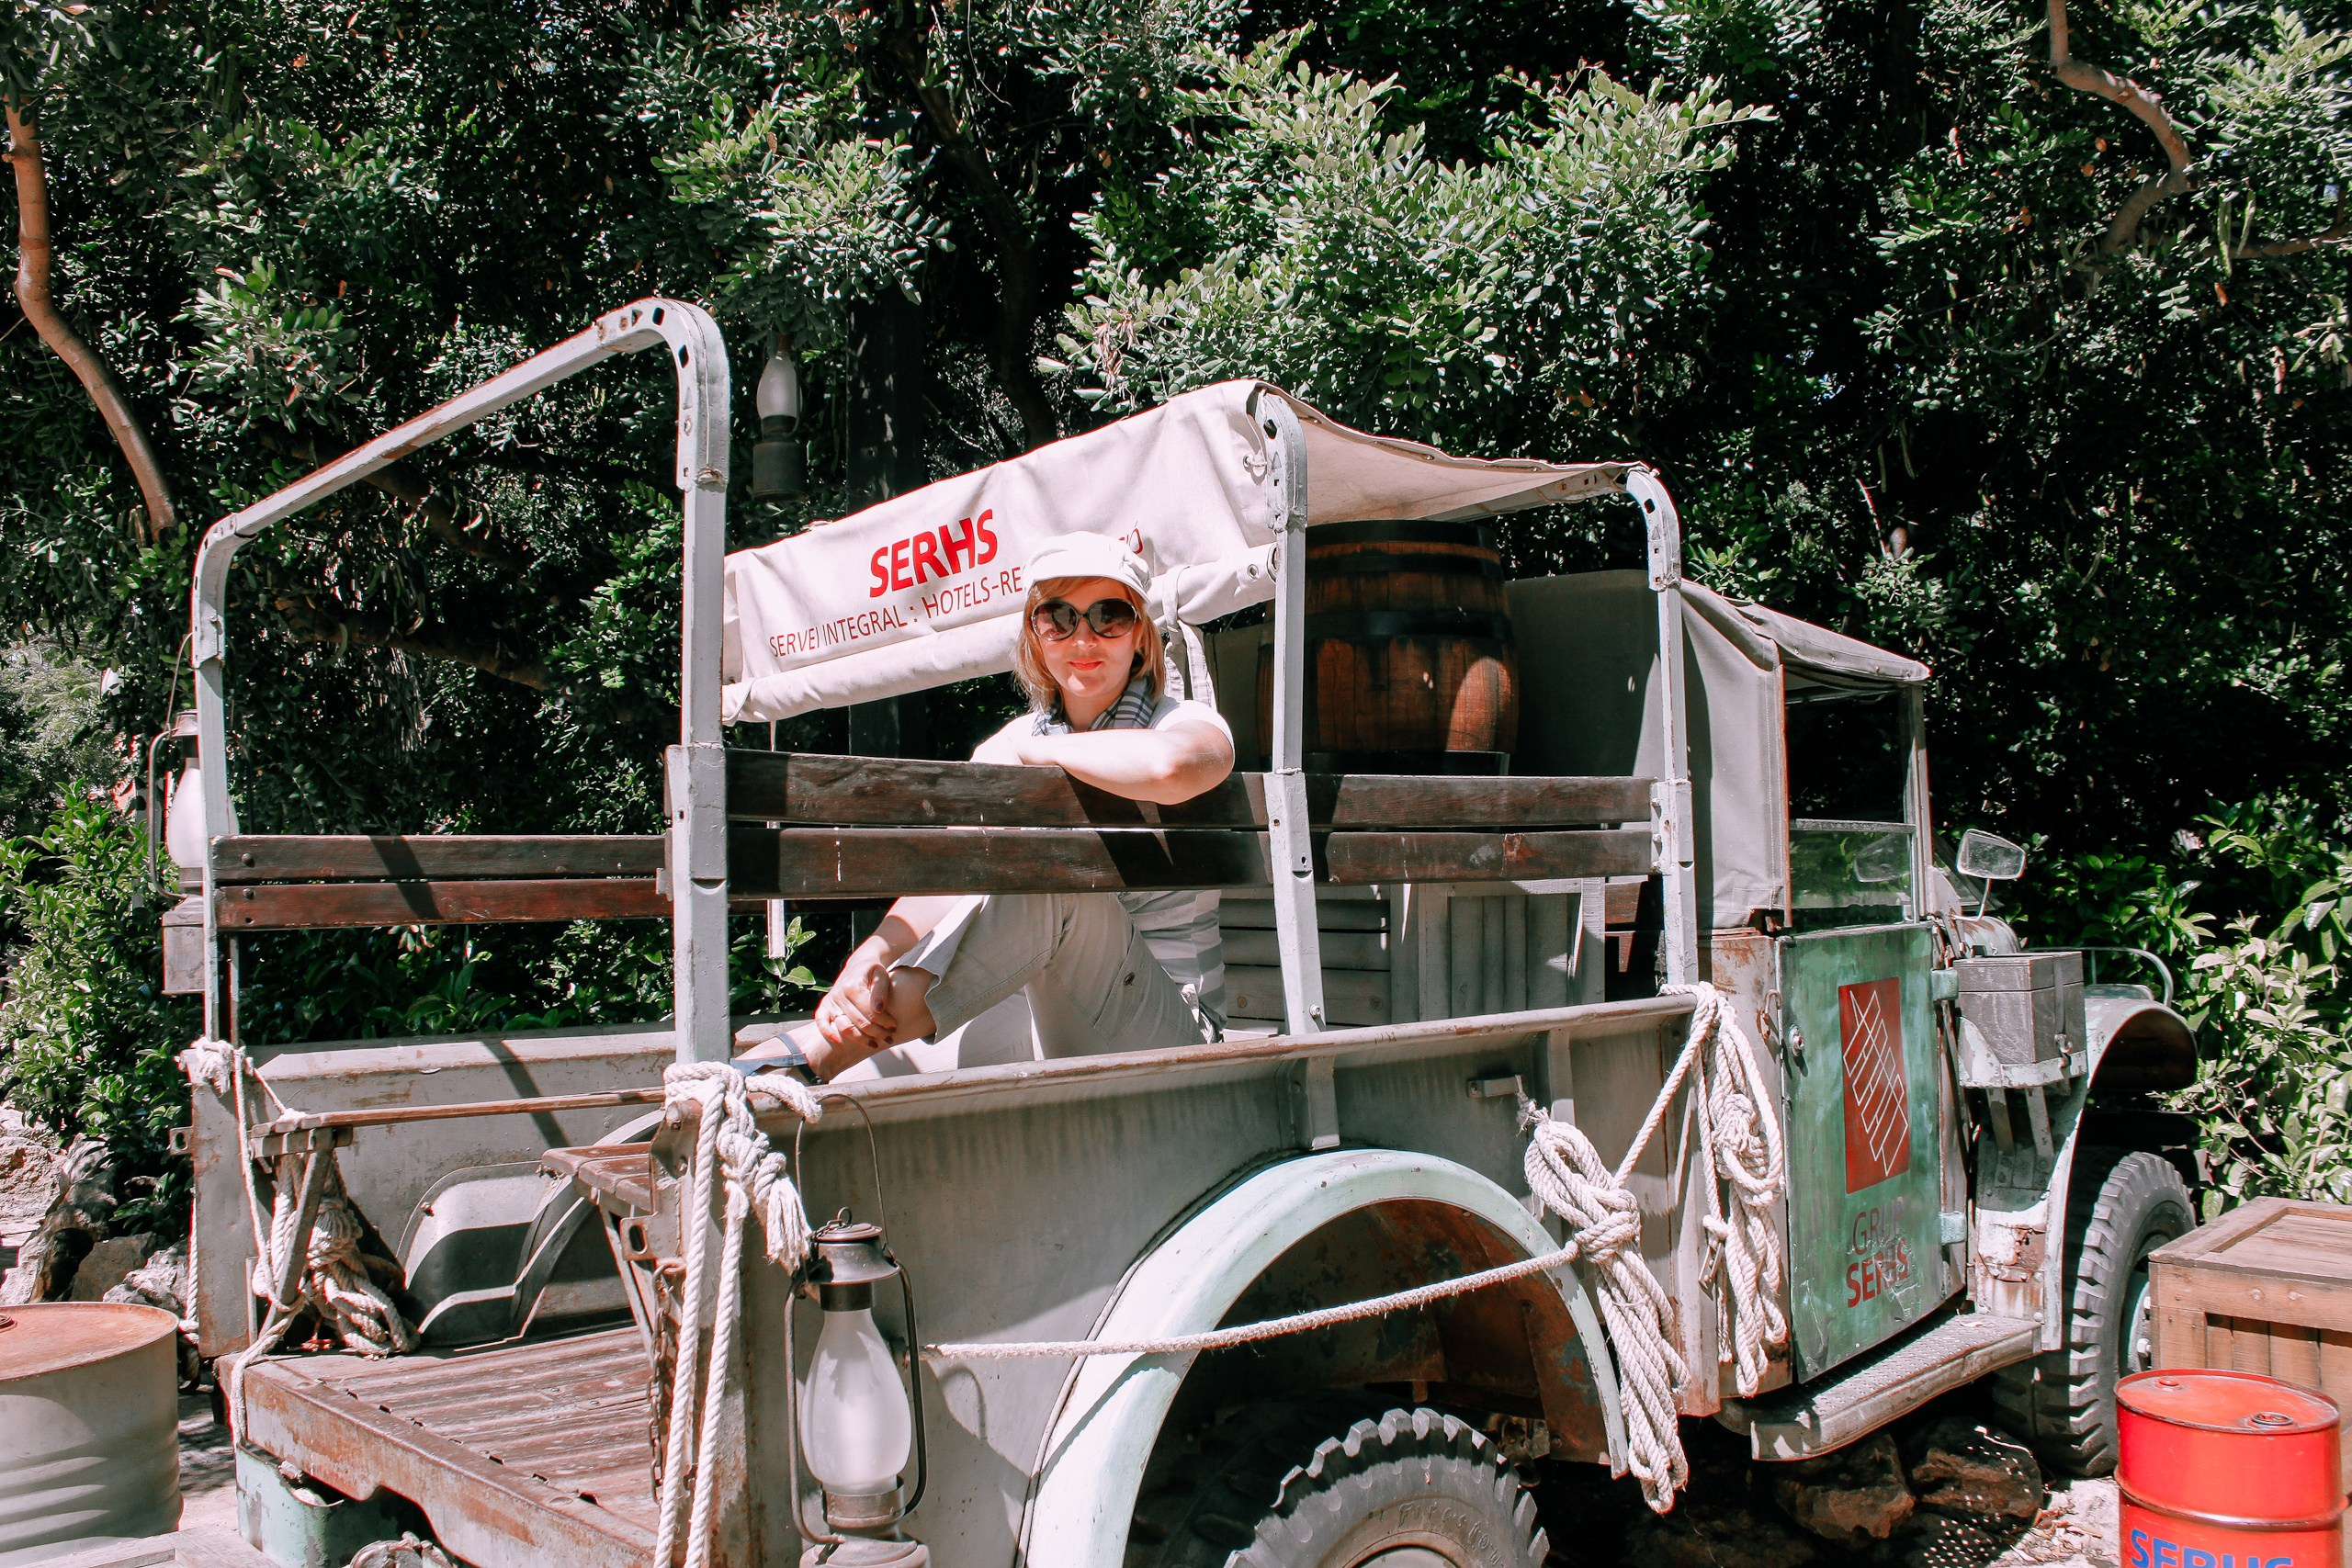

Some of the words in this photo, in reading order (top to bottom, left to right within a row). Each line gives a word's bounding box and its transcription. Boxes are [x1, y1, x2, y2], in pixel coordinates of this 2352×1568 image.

[869, 508, 998, 598] SERHS
[769, 626, 820, 658] SERVEI
[922, 565, 1026, 619] HOTELS-RE
